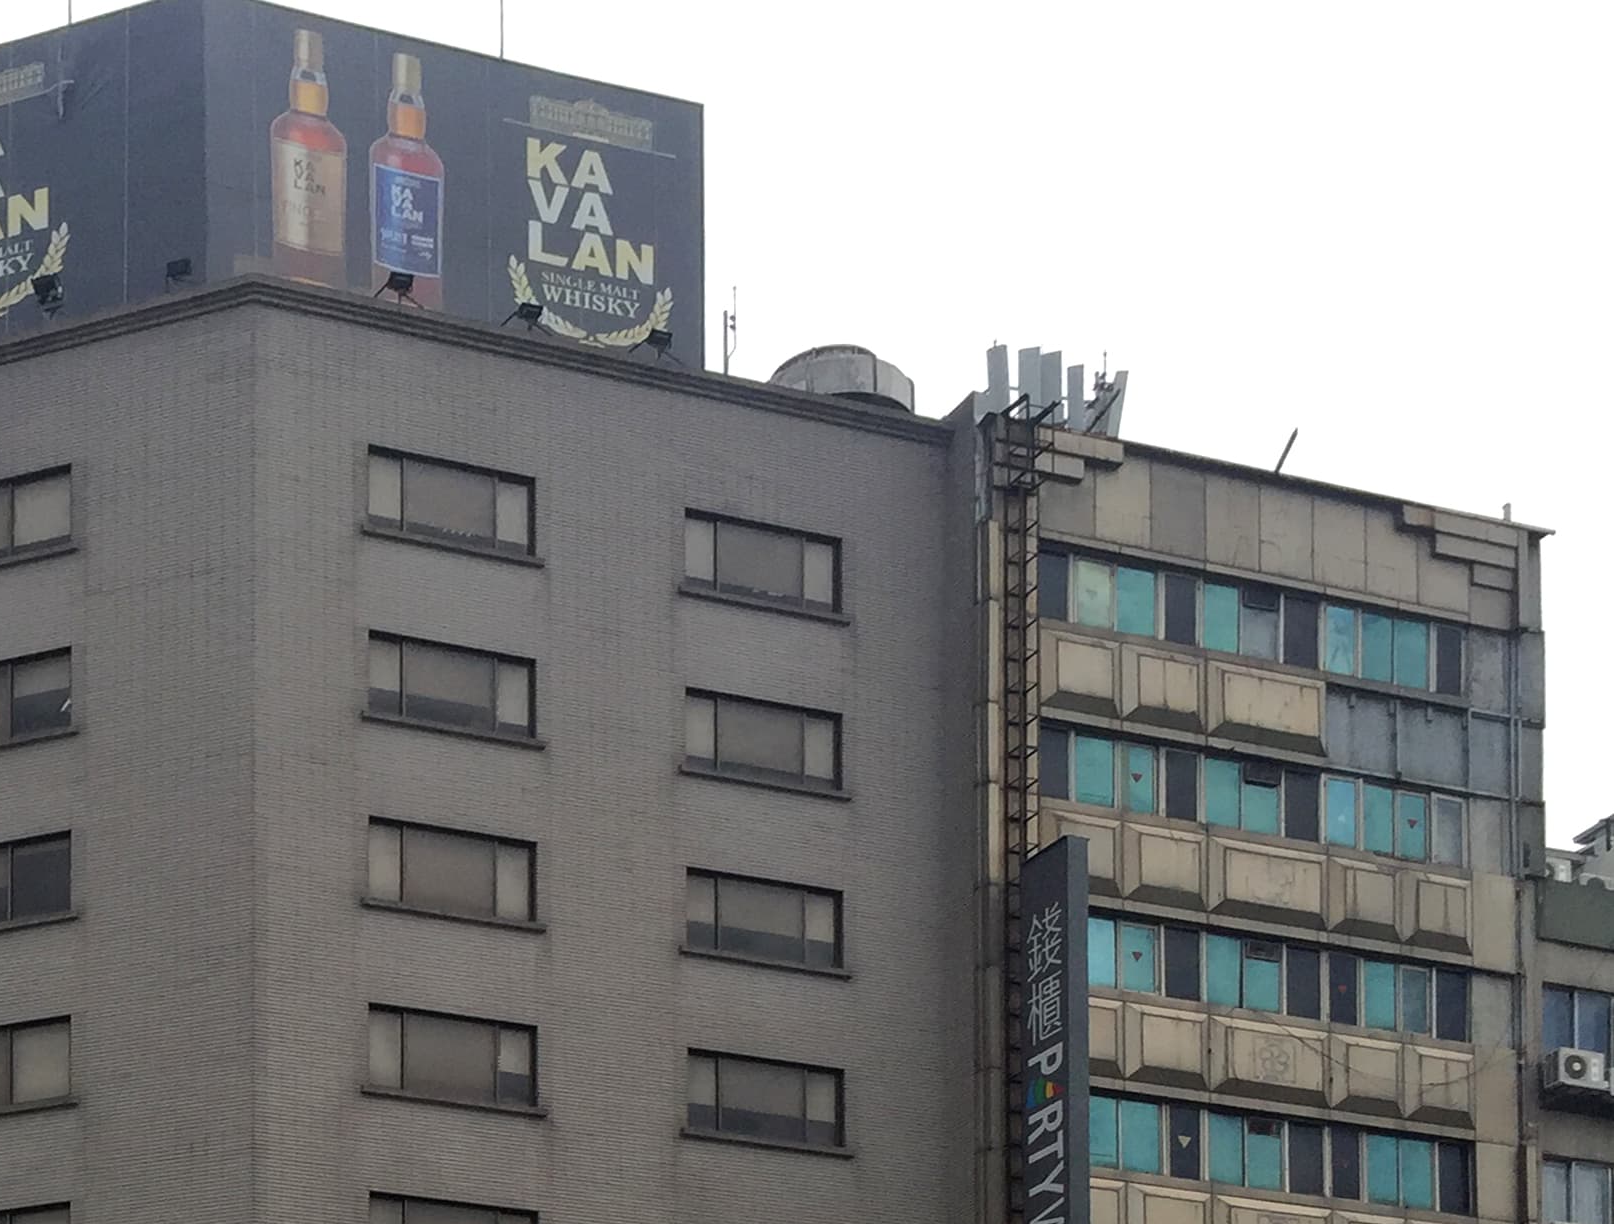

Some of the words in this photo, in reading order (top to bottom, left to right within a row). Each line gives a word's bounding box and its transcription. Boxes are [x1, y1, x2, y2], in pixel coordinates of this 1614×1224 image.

[541, 272, 598, 291] SINGLE
[600, 283, 640, 300] MALT
[542, 283, 640, 318] WHISKY
[1027, 902, 1063, 1046] 錢櫃
